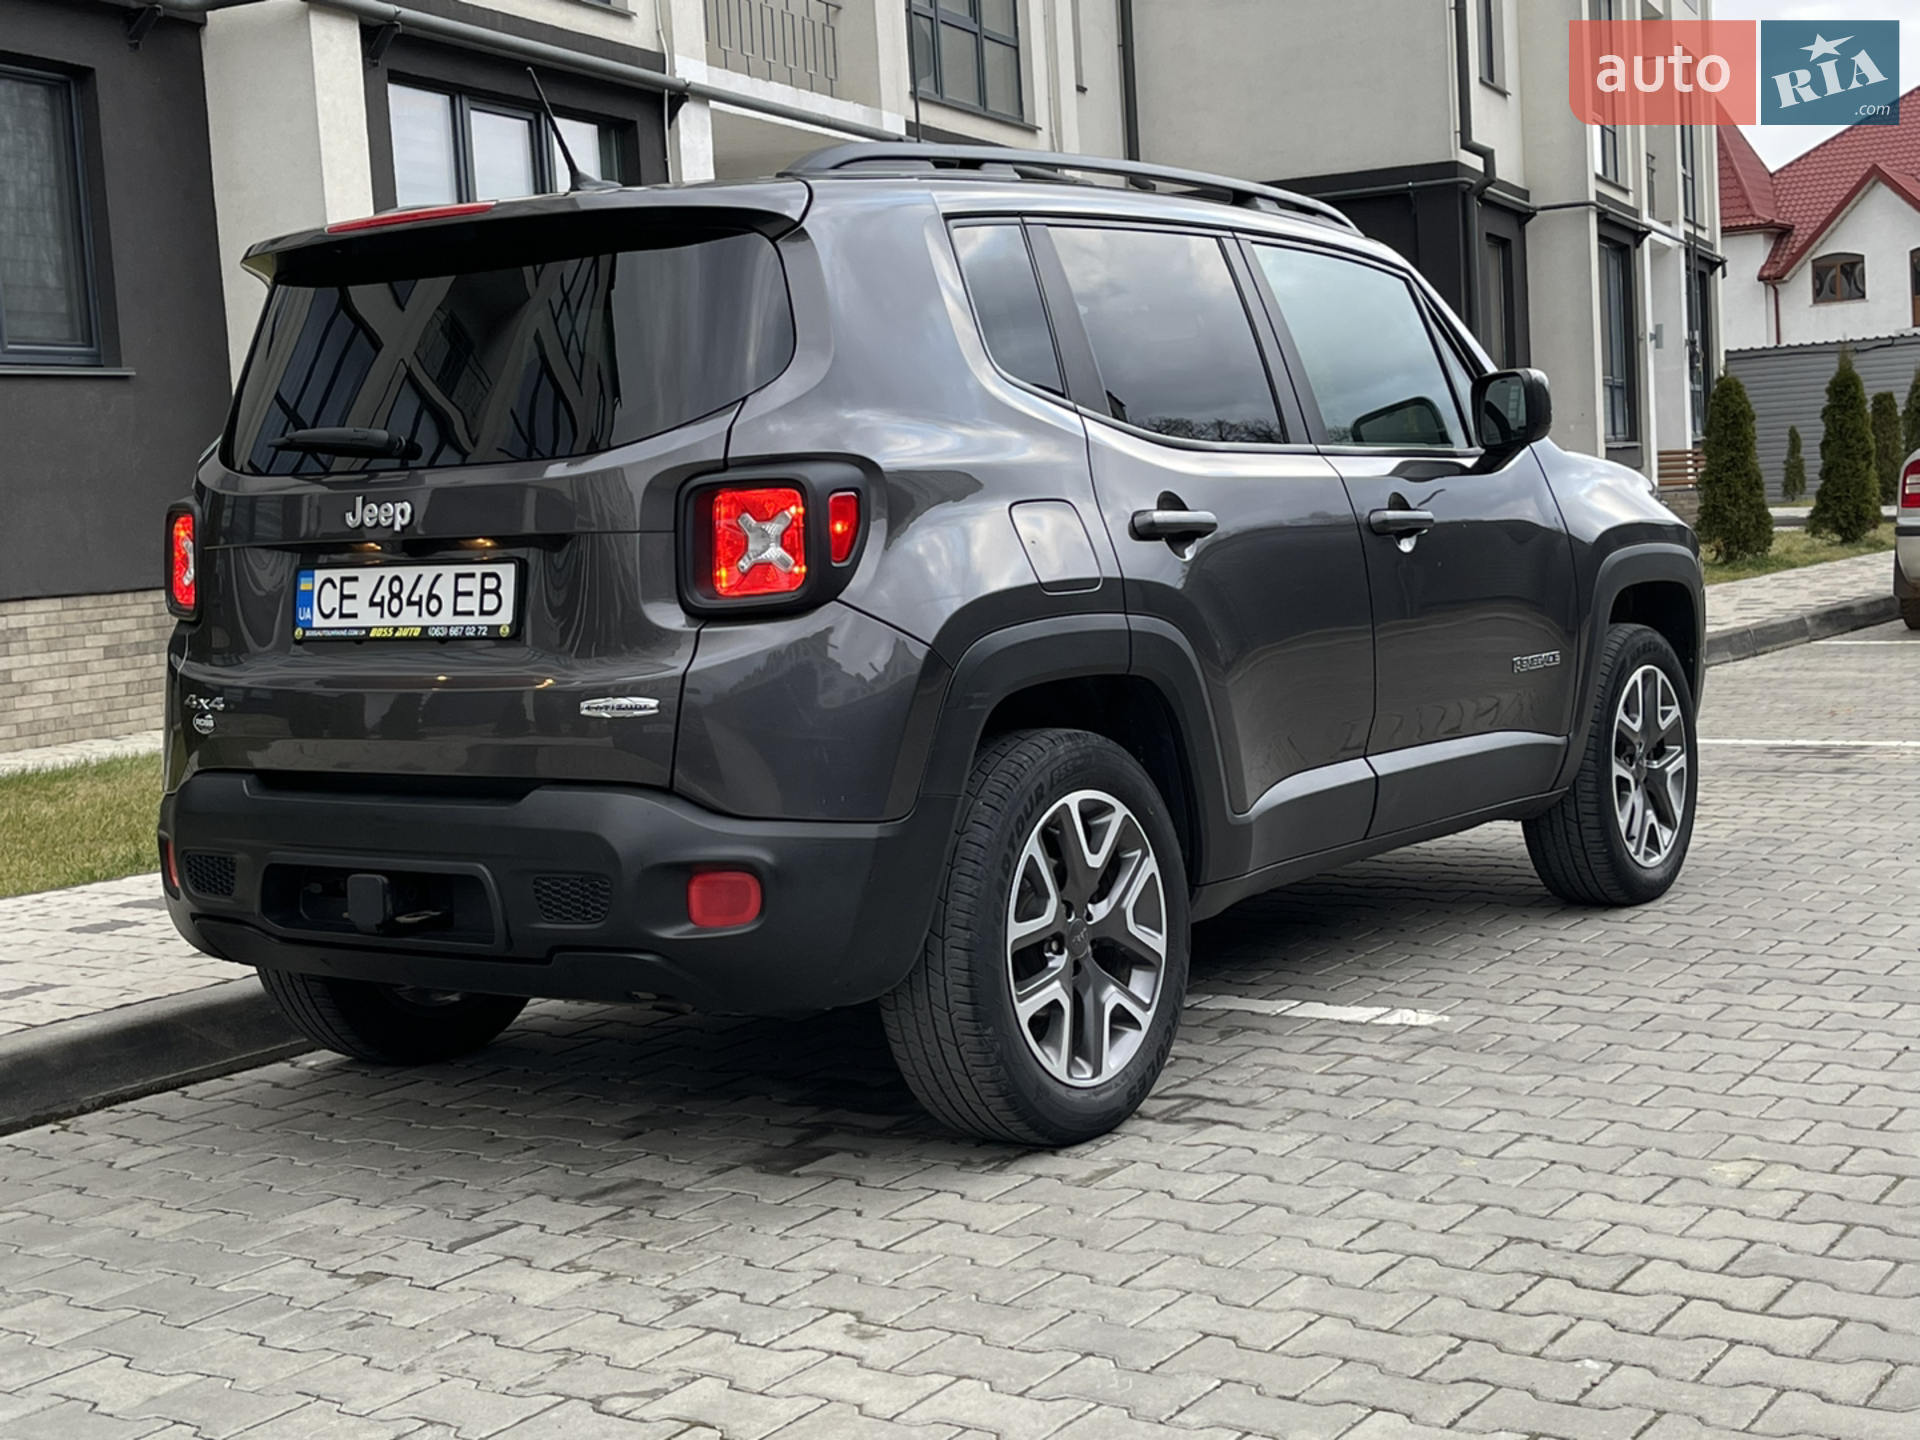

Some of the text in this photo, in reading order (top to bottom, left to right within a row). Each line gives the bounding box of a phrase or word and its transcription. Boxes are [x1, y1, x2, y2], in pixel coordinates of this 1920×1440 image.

[345, 496, 413, 531] Jeep
[317, 571, 503, 620] CE 4846 EB
[298, 607, 313, 621] UA
[369, 626, 421, 637] BOSS AUTO
